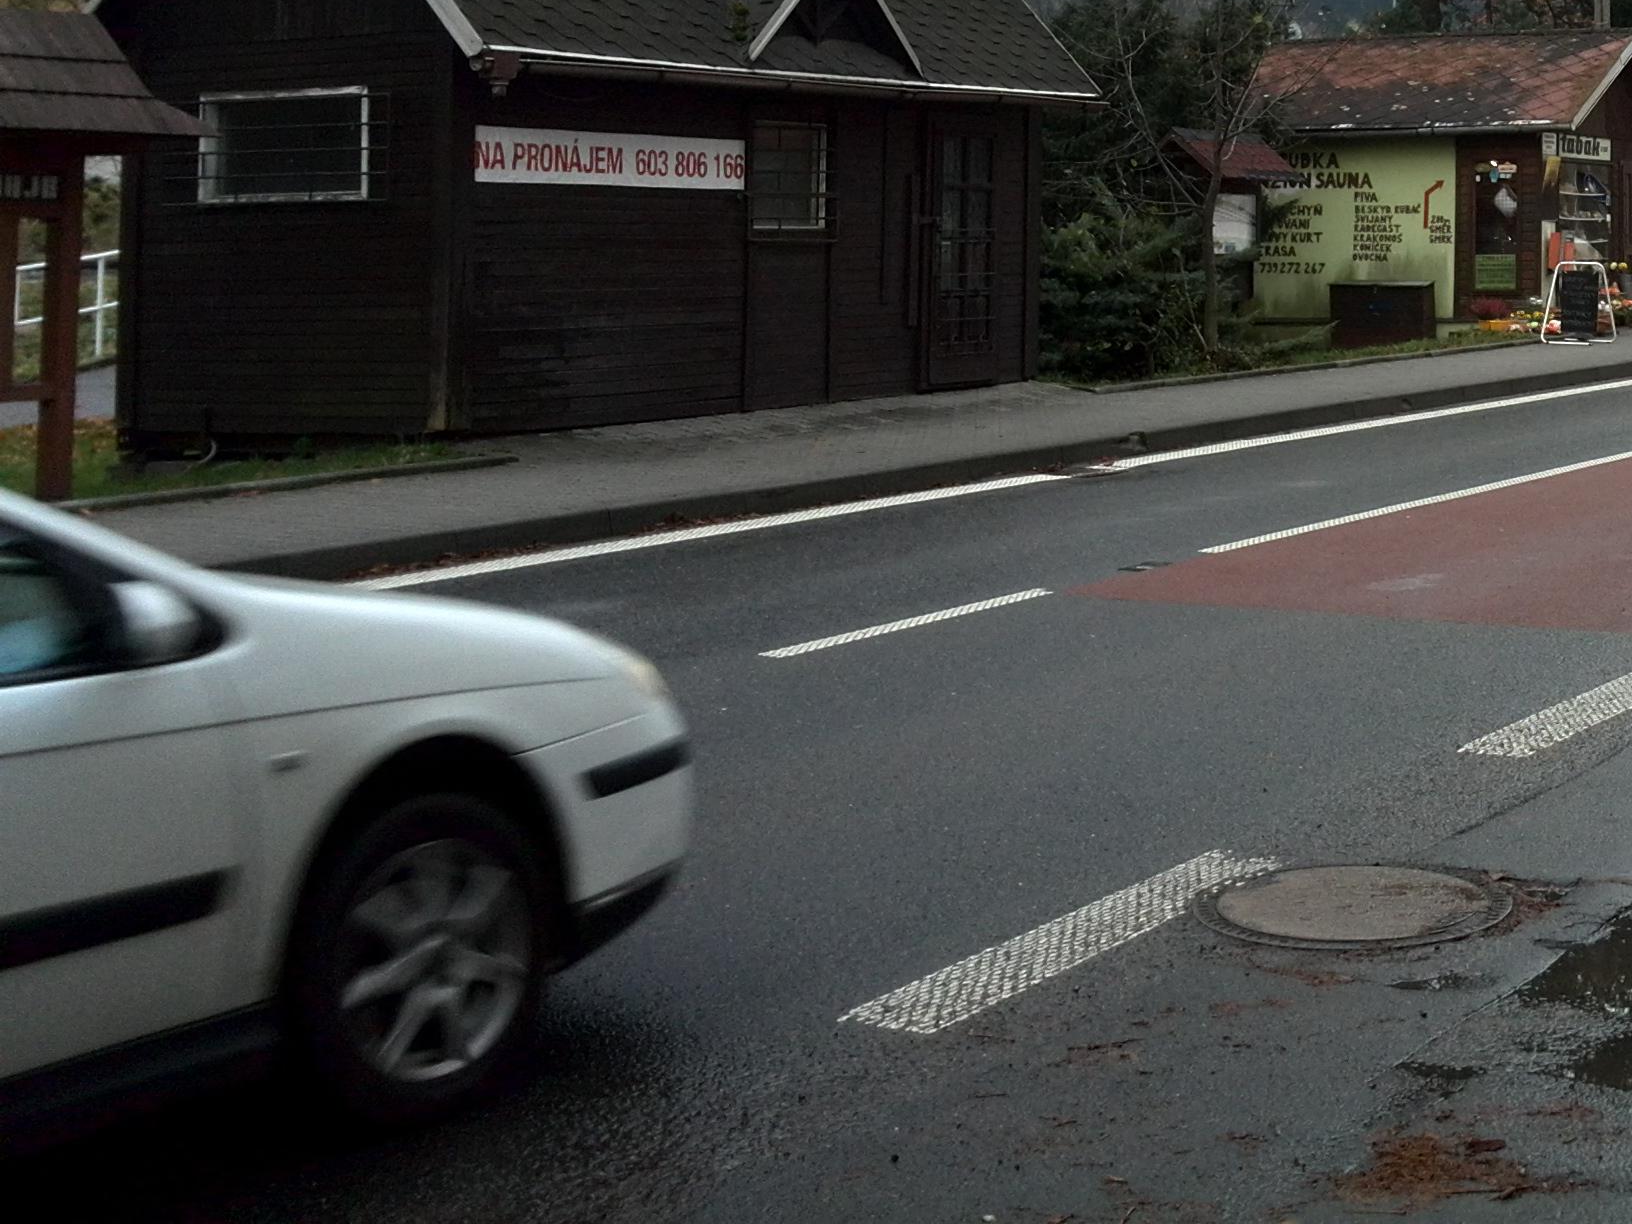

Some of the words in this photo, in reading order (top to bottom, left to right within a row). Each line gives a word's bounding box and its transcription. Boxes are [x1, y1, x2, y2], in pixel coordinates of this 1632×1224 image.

[1559, 134, 1600, 157] tabak
[472, 141, 505, 170] NA
[511, 138, 623, 175] PRONÁJEM
[635, 149, 669, 176] 603
[675, 151, 708, 178] 806
[713, 153, 745, 180] 166
[1315, 171, 1373, 189] SAUNA
[1354, 191, 1378, 203] PIVA
[1353, 215, 1393, 224] SVIJANY
[1353, 224, 1402, 233] RADEGAST
[1290, 232, 1323, 244] KURT
[1258, 261, 1278, 274] 739
[1279, 261, 1301, 274] 272
[1304, 261, 1326, 274] 267
